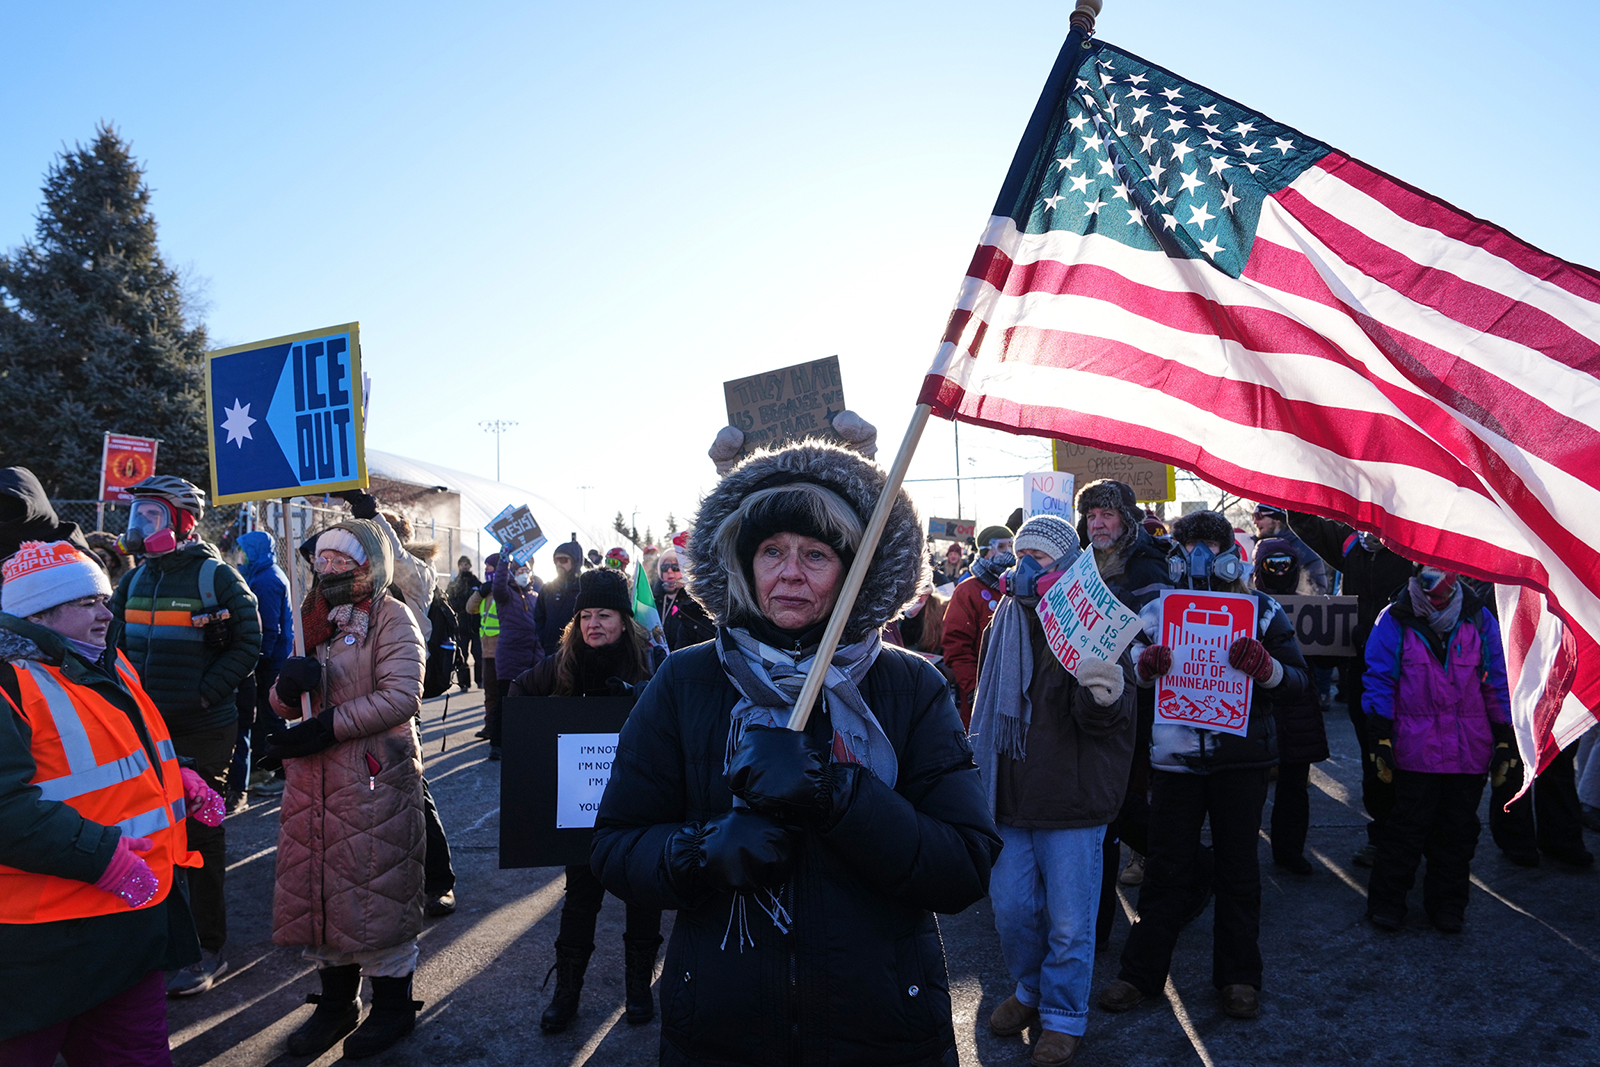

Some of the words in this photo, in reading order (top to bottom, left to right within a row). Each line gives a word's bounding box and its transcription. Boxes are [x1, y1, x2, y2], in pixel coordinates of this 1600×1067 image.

[292, 337, 349, 412] ICE
[733, 371, 786, 406] THEY
[790, 360, 841, 395] HATE
[729, 410, 754, 431] US
[759, 391, 822, 425] BECAUSE
[822, 389, 842, 406] WE
[782, 412, 818, 435] HATE
[295, 408, 350, 482] OUT
[1087, 455, 1134, 474] OPPRESS
[1032, 476, 1054, 493] NO
[1062, 478, 1074, 496] ICE
[1042, 496, 1069, 513] ONLY
[497, 512, 537, 543] RESIST
[1066, 579, 1104, 632] HEART
[1084, 570, 1121, 620] SHAPE
[1120, 613, 1137, 631] of
[1048, 582, 1080, 640] SHADOW
[1080, 634, 1091, 649] of
[1296, 603, 1358, 647] OUT
[1044, 611, 1084, 677] NEIGHB
[1099, 634, 1117, 652] the
[1191, 647, 1220, 664] I.C.E.
[1183, 661, 1207, 677] OUT
[1210, 664, 1227, 678] OF
[1165, 674, 1244, 696] MINNEAPOLIS
[580, 746, 595, 755] I'M
[598, 745, 617, 754] NOT
[578, 762, 593, 771] I'M
[588, 777, 603, 786] I'M
[579, 802, 600, 812] YOU
